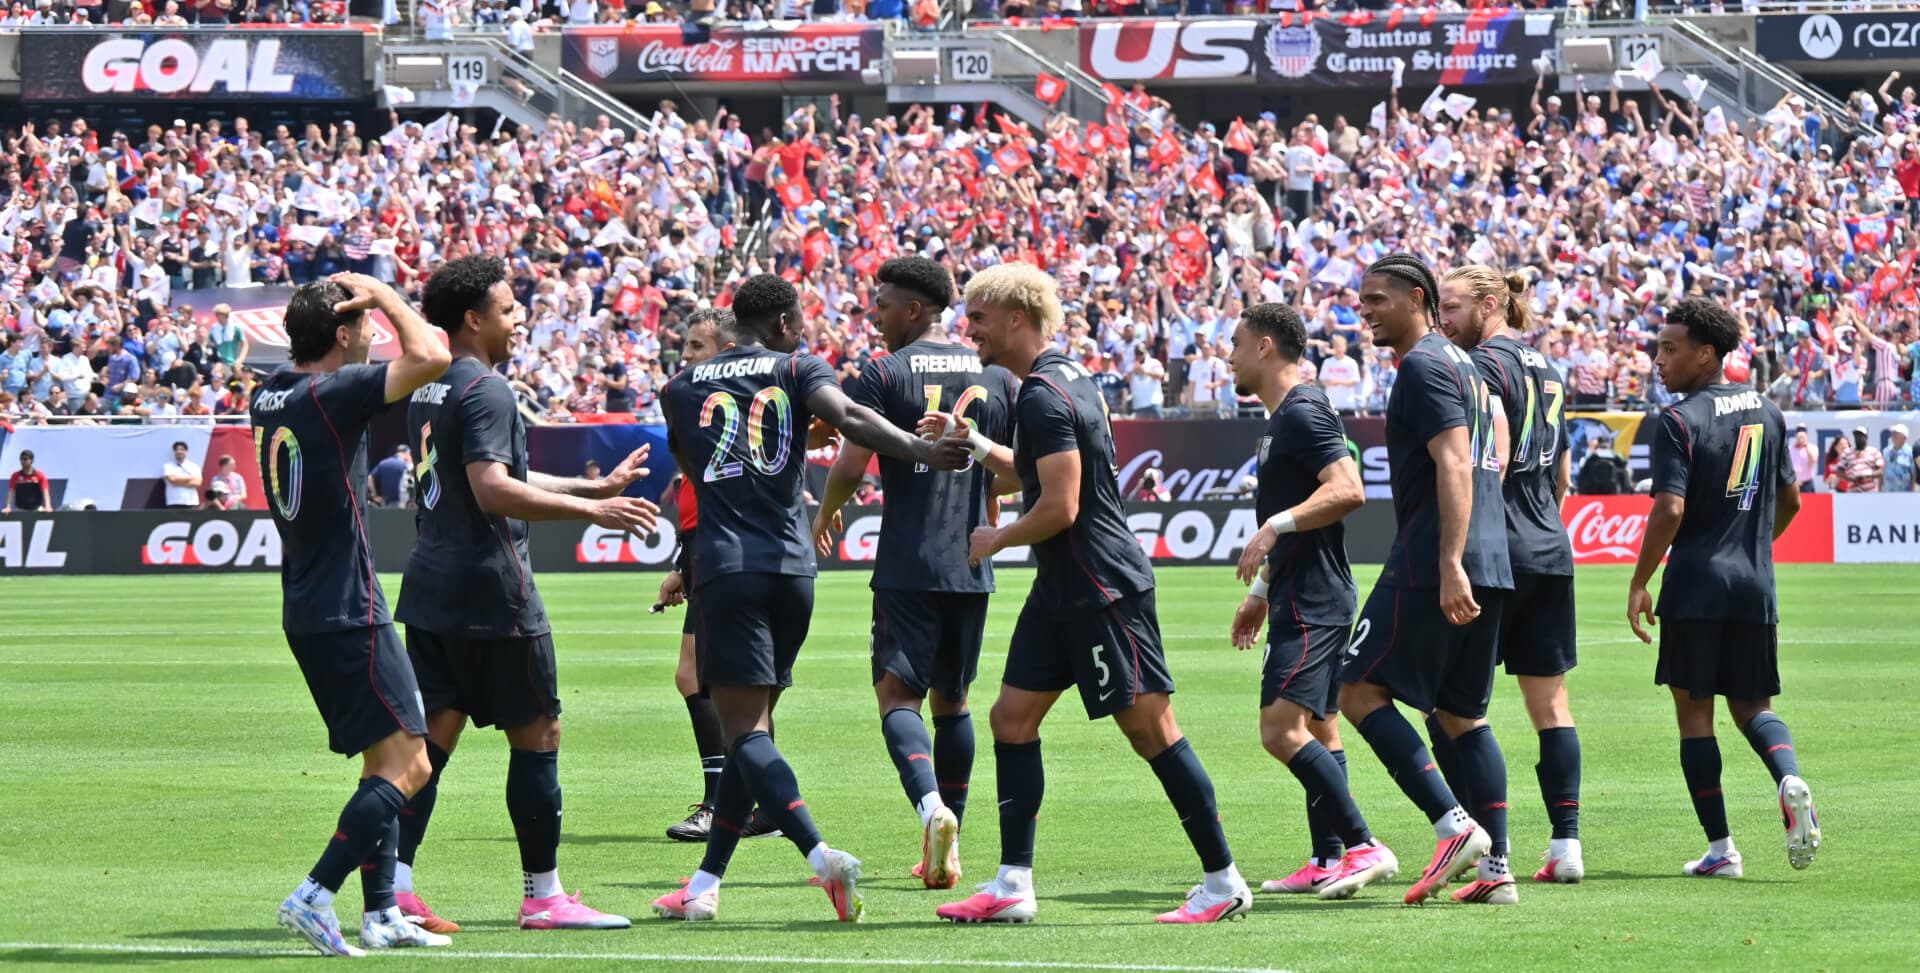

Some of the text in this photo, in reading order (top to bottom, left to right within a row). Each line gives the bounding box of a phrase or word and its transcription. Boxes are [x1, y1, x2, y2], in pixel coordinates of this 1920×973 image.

[742, 36, 860, 52] SEND-OFF
[1090, 21, 1257, 79] US
[1345, 24, 1498, 49] Juntos Hoy
[1853, 22, 1920, 48] razr
[81, 38, 295, 93] GOAL
[452, 60, 483, 80] 119
[637, 38, 734, 73] Coca-Cola
[743, 51, 861, 73] MATCH
[956, 55, 988, 75] 120
[1411, 50, 1517, 72] Siempre
[692, 357, 776, 383] BALOGUN
[1513, 375, 1565, 466] 13
[1714, 390, 1763, 416] ADAMS
[699, 386, 793, 483] 20
[1725, 423, 1764, 511] 4
[147, 518, 283, 567] GOA
[582, 516, 676, 565] GO
[1127, 509, 1262, 560] GOA
[1091, 644, 1110, 688] 5
